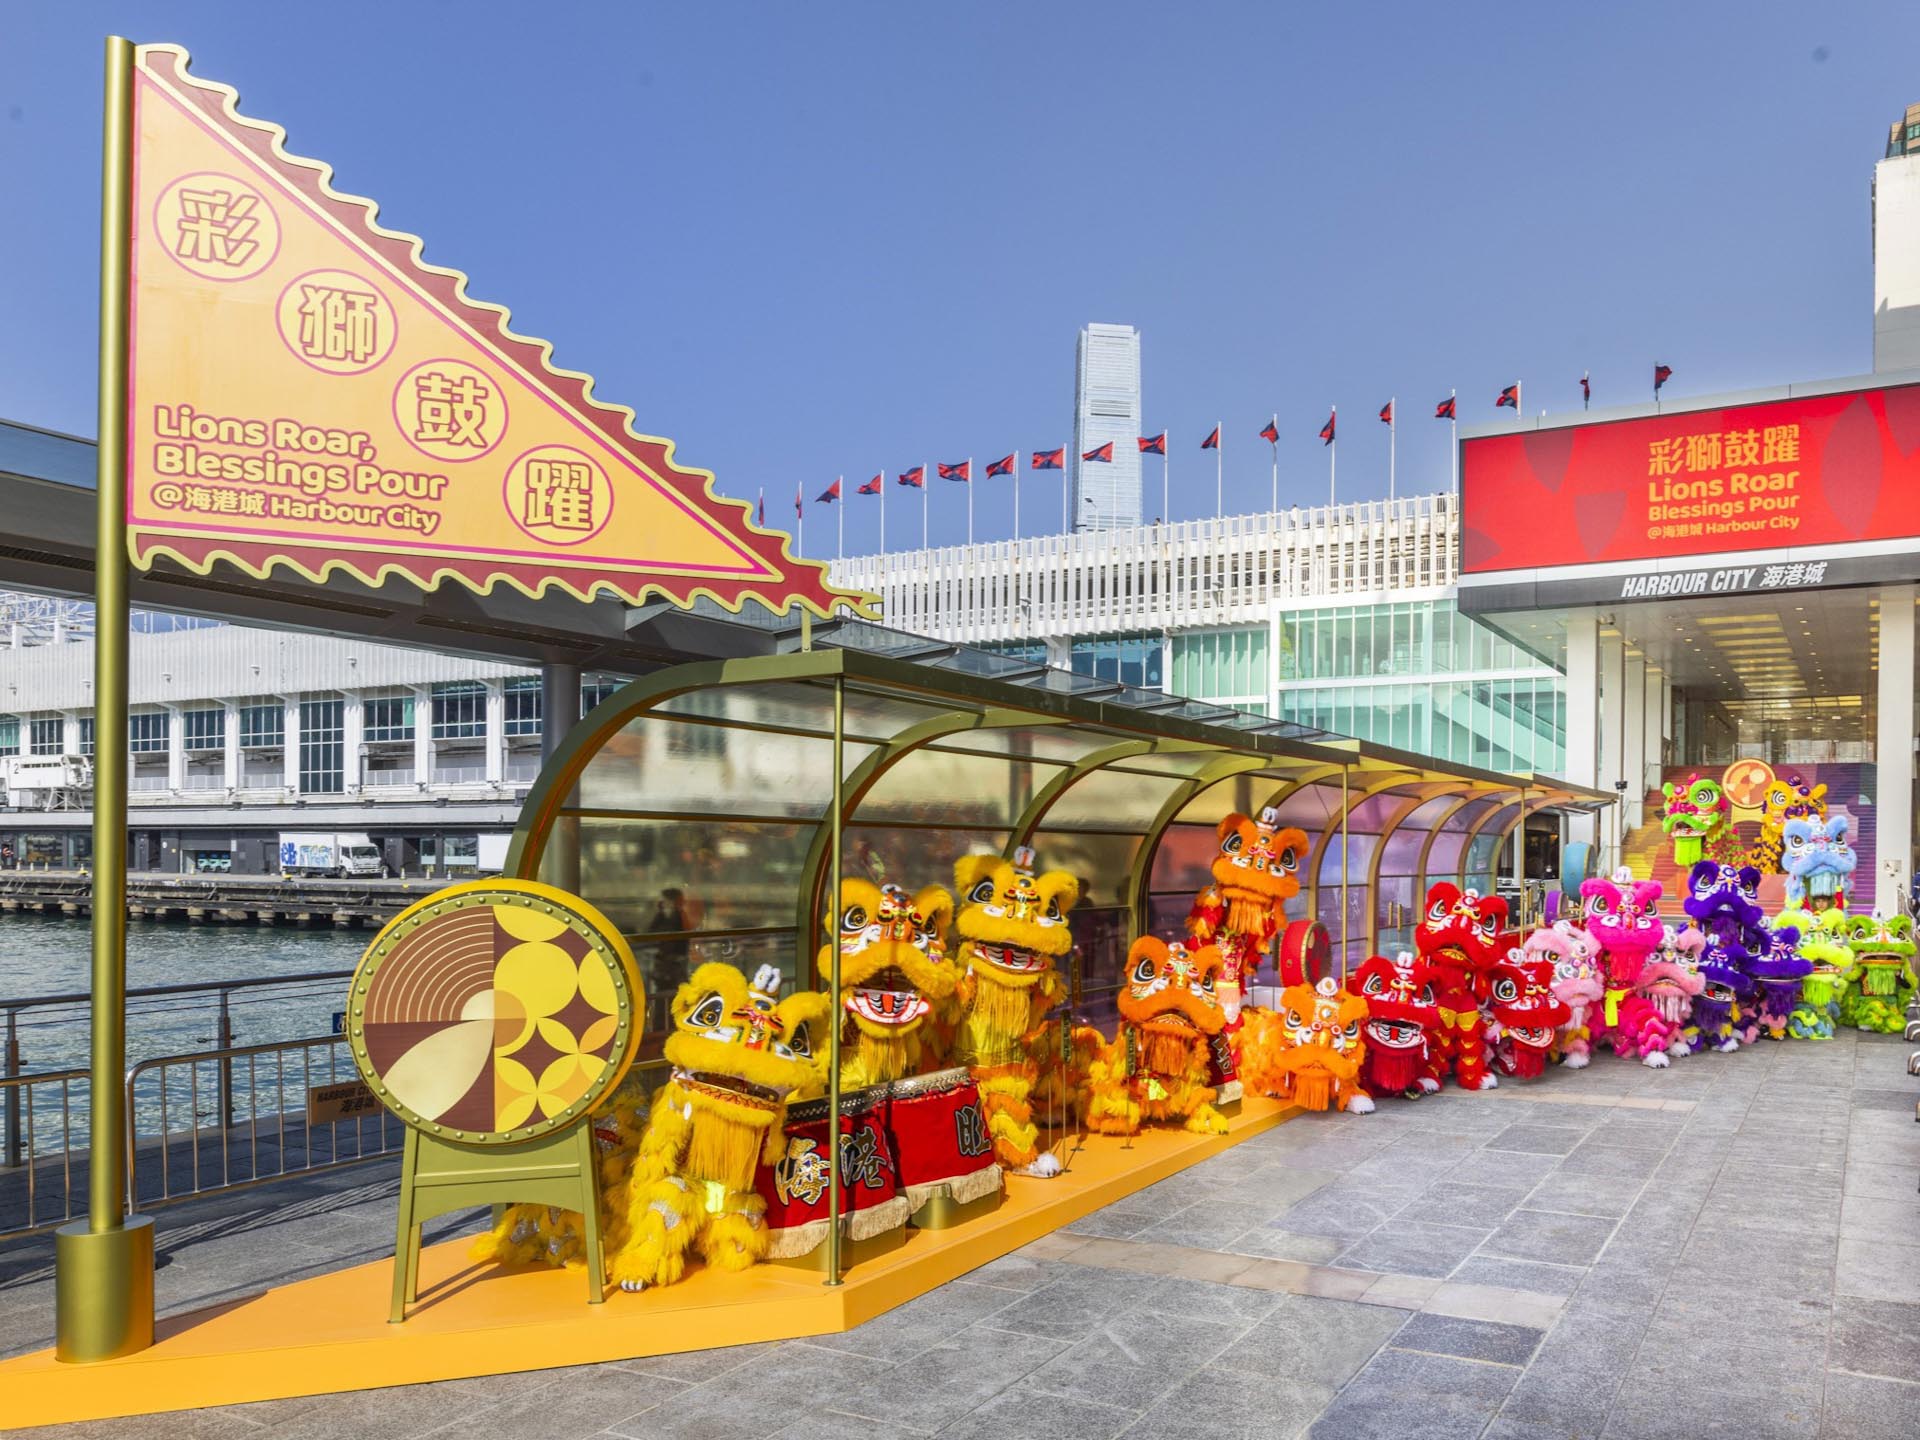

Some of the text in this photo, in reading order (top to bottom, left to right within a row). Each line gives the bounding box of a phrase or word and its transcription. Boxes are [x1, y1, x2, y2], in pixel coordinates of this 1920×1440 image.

[177, 189, 593, 531] 彩 獅 鼓 躍
[155, 404, 376, 462] Lions Roar,
[1648, 424, 1800, 476] 彩獅鼓躍
[155, 443, 448, 500] Blessings Pour
[1649, 471, 1800, 502] Lions Roar
[270, 496, 383, 527] Harbour
[386, 504, 441, 535] City
[1649, 495, 1800, 521] Blessings Pour
[1706, 519, 1767, 534] Harbour
[1769, 515, 1800, 530] City
[1621, 562, 1828, 597] HARBOUR CITY 海港城
